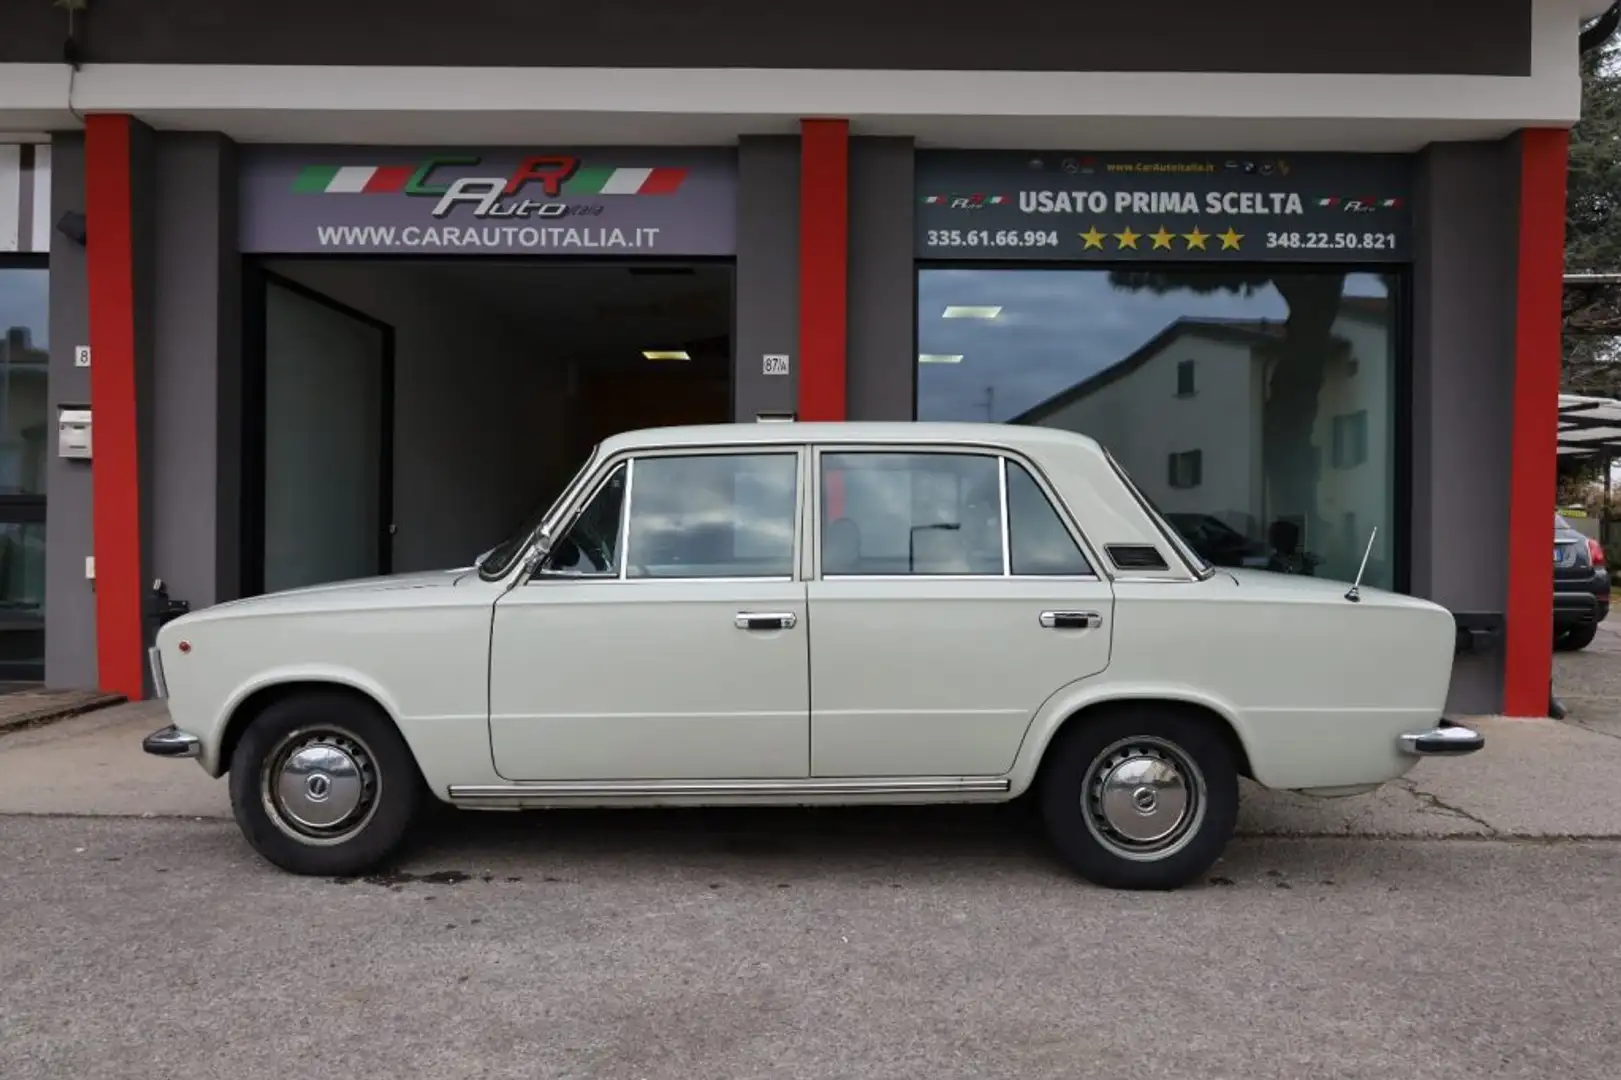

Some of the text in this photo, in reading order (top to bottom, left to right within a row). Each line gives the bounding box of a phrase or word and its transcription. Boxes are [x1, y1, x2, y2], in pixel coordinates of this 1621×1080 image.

[1019, 191, 1303, 214] USATO PRIMA SCELTA
[318, 226, 660, 249] WWW.CARAUTOITALIA.IT
[927, 230, 1059, 246] 335.61.66.994
[1266, 232, 1396, 248] 348.22.50.821
